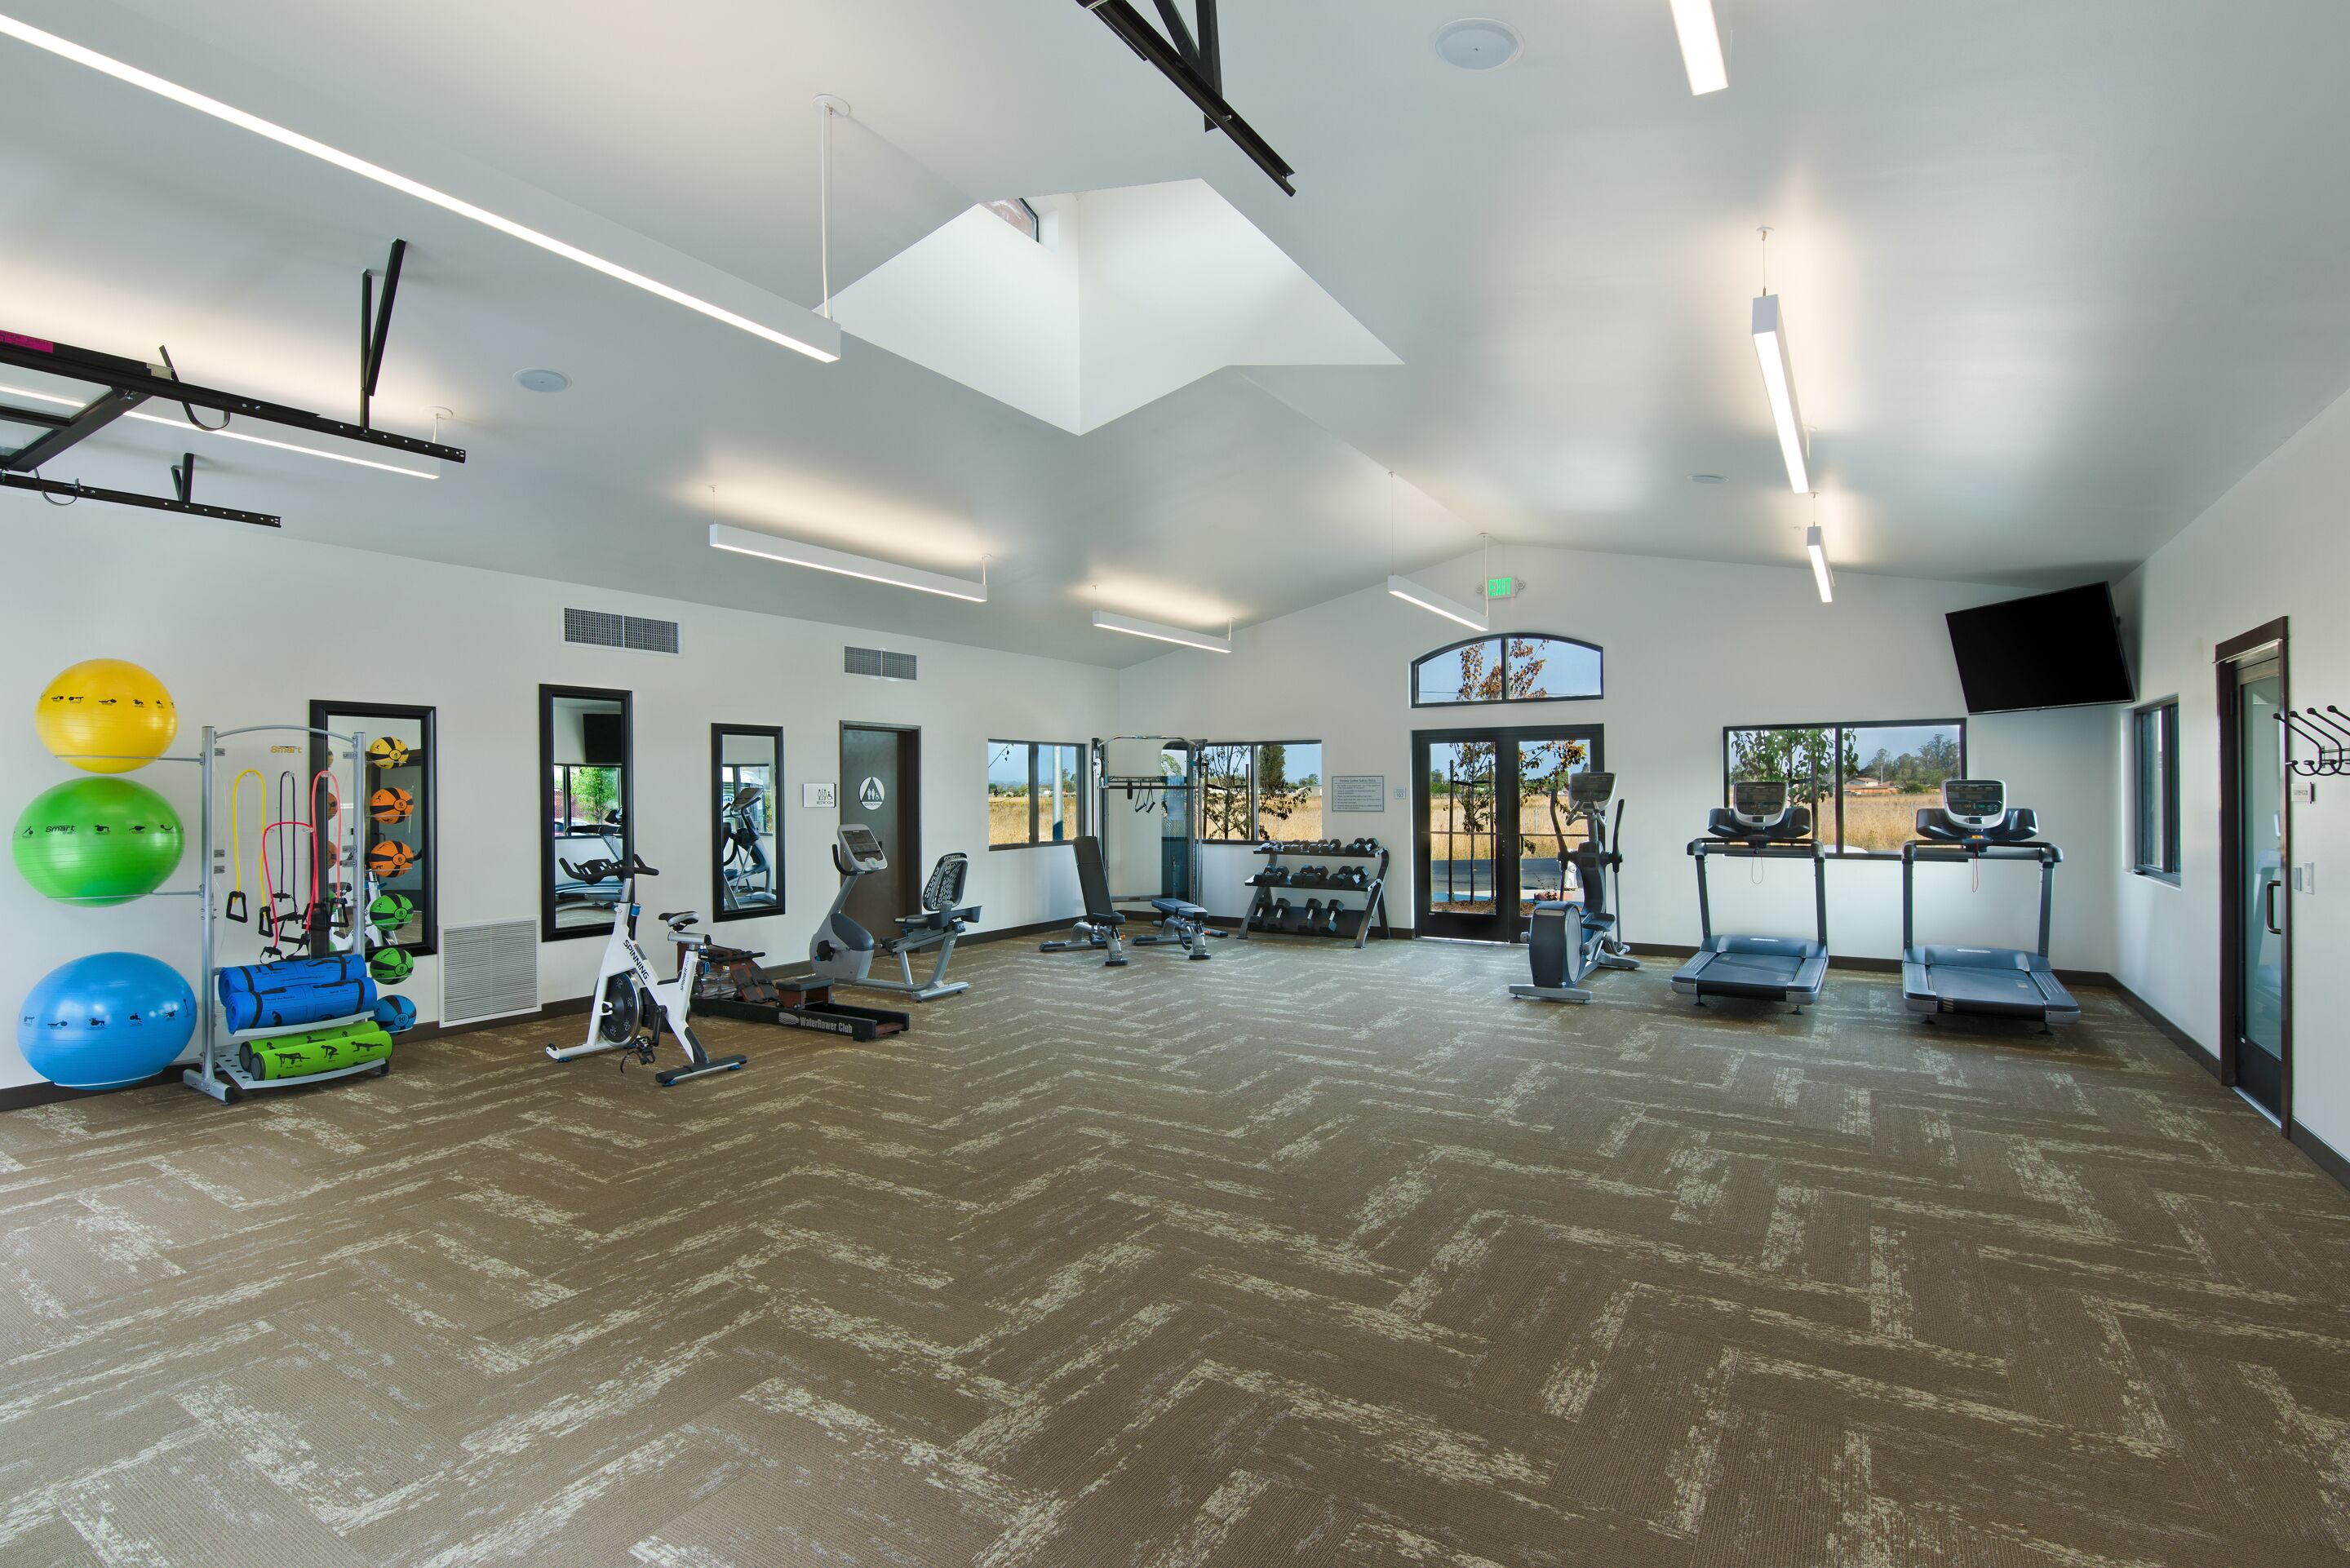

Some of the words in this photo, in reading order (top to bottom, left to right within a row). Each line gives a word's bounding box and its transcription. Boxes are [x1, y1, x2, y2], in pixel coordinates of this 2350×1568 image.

[1489, 578, 1511, 596] EXIT
[623, 939, 650, 981] SPINNING
[800, 1017, 837, 1031] WaterRower
[838, 1022, 853, 1034] Club
